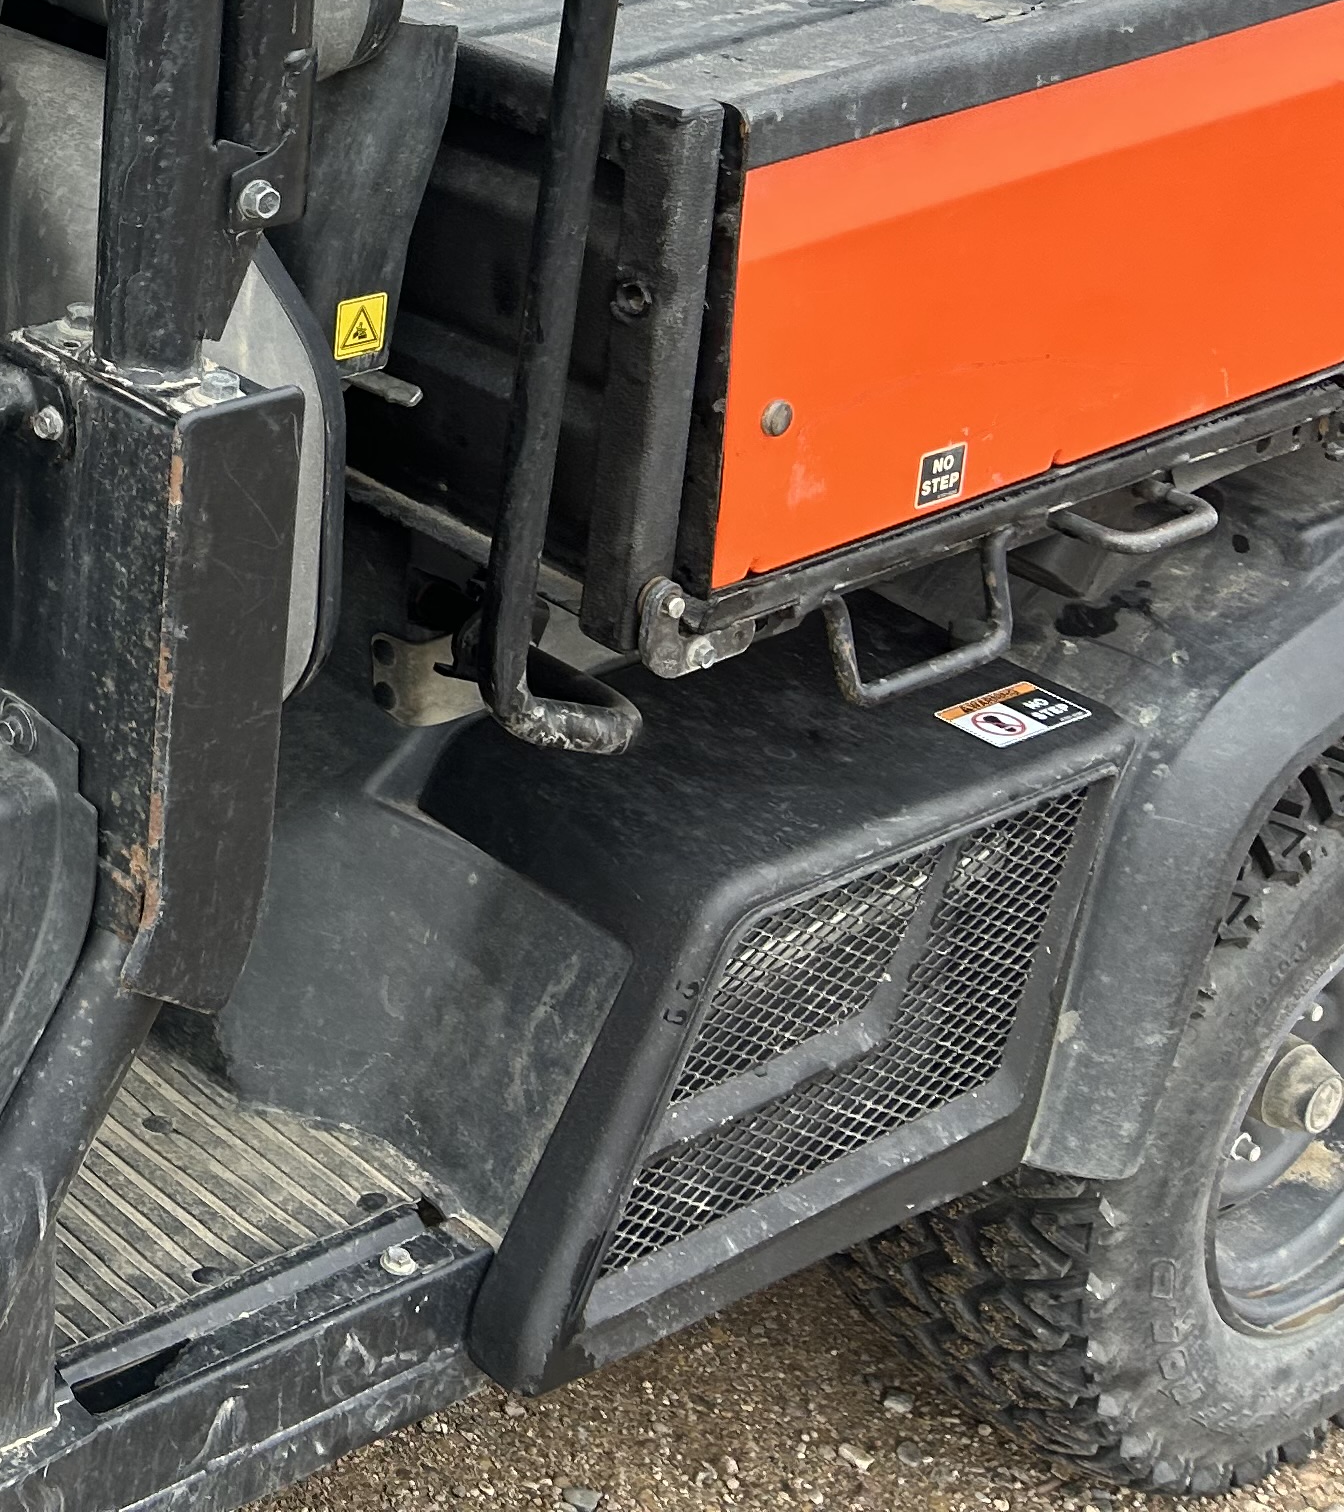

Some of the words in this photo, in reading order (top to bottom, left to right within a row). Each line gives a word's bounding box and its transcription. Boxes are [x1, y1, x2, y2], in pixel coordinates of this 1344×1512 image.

[932, 454, 955, 474] NO
[921, 471, 960, 496] STEP
[1022, 698, 1050, 710] NO
[1031, 703, 1070, 721] STEP
